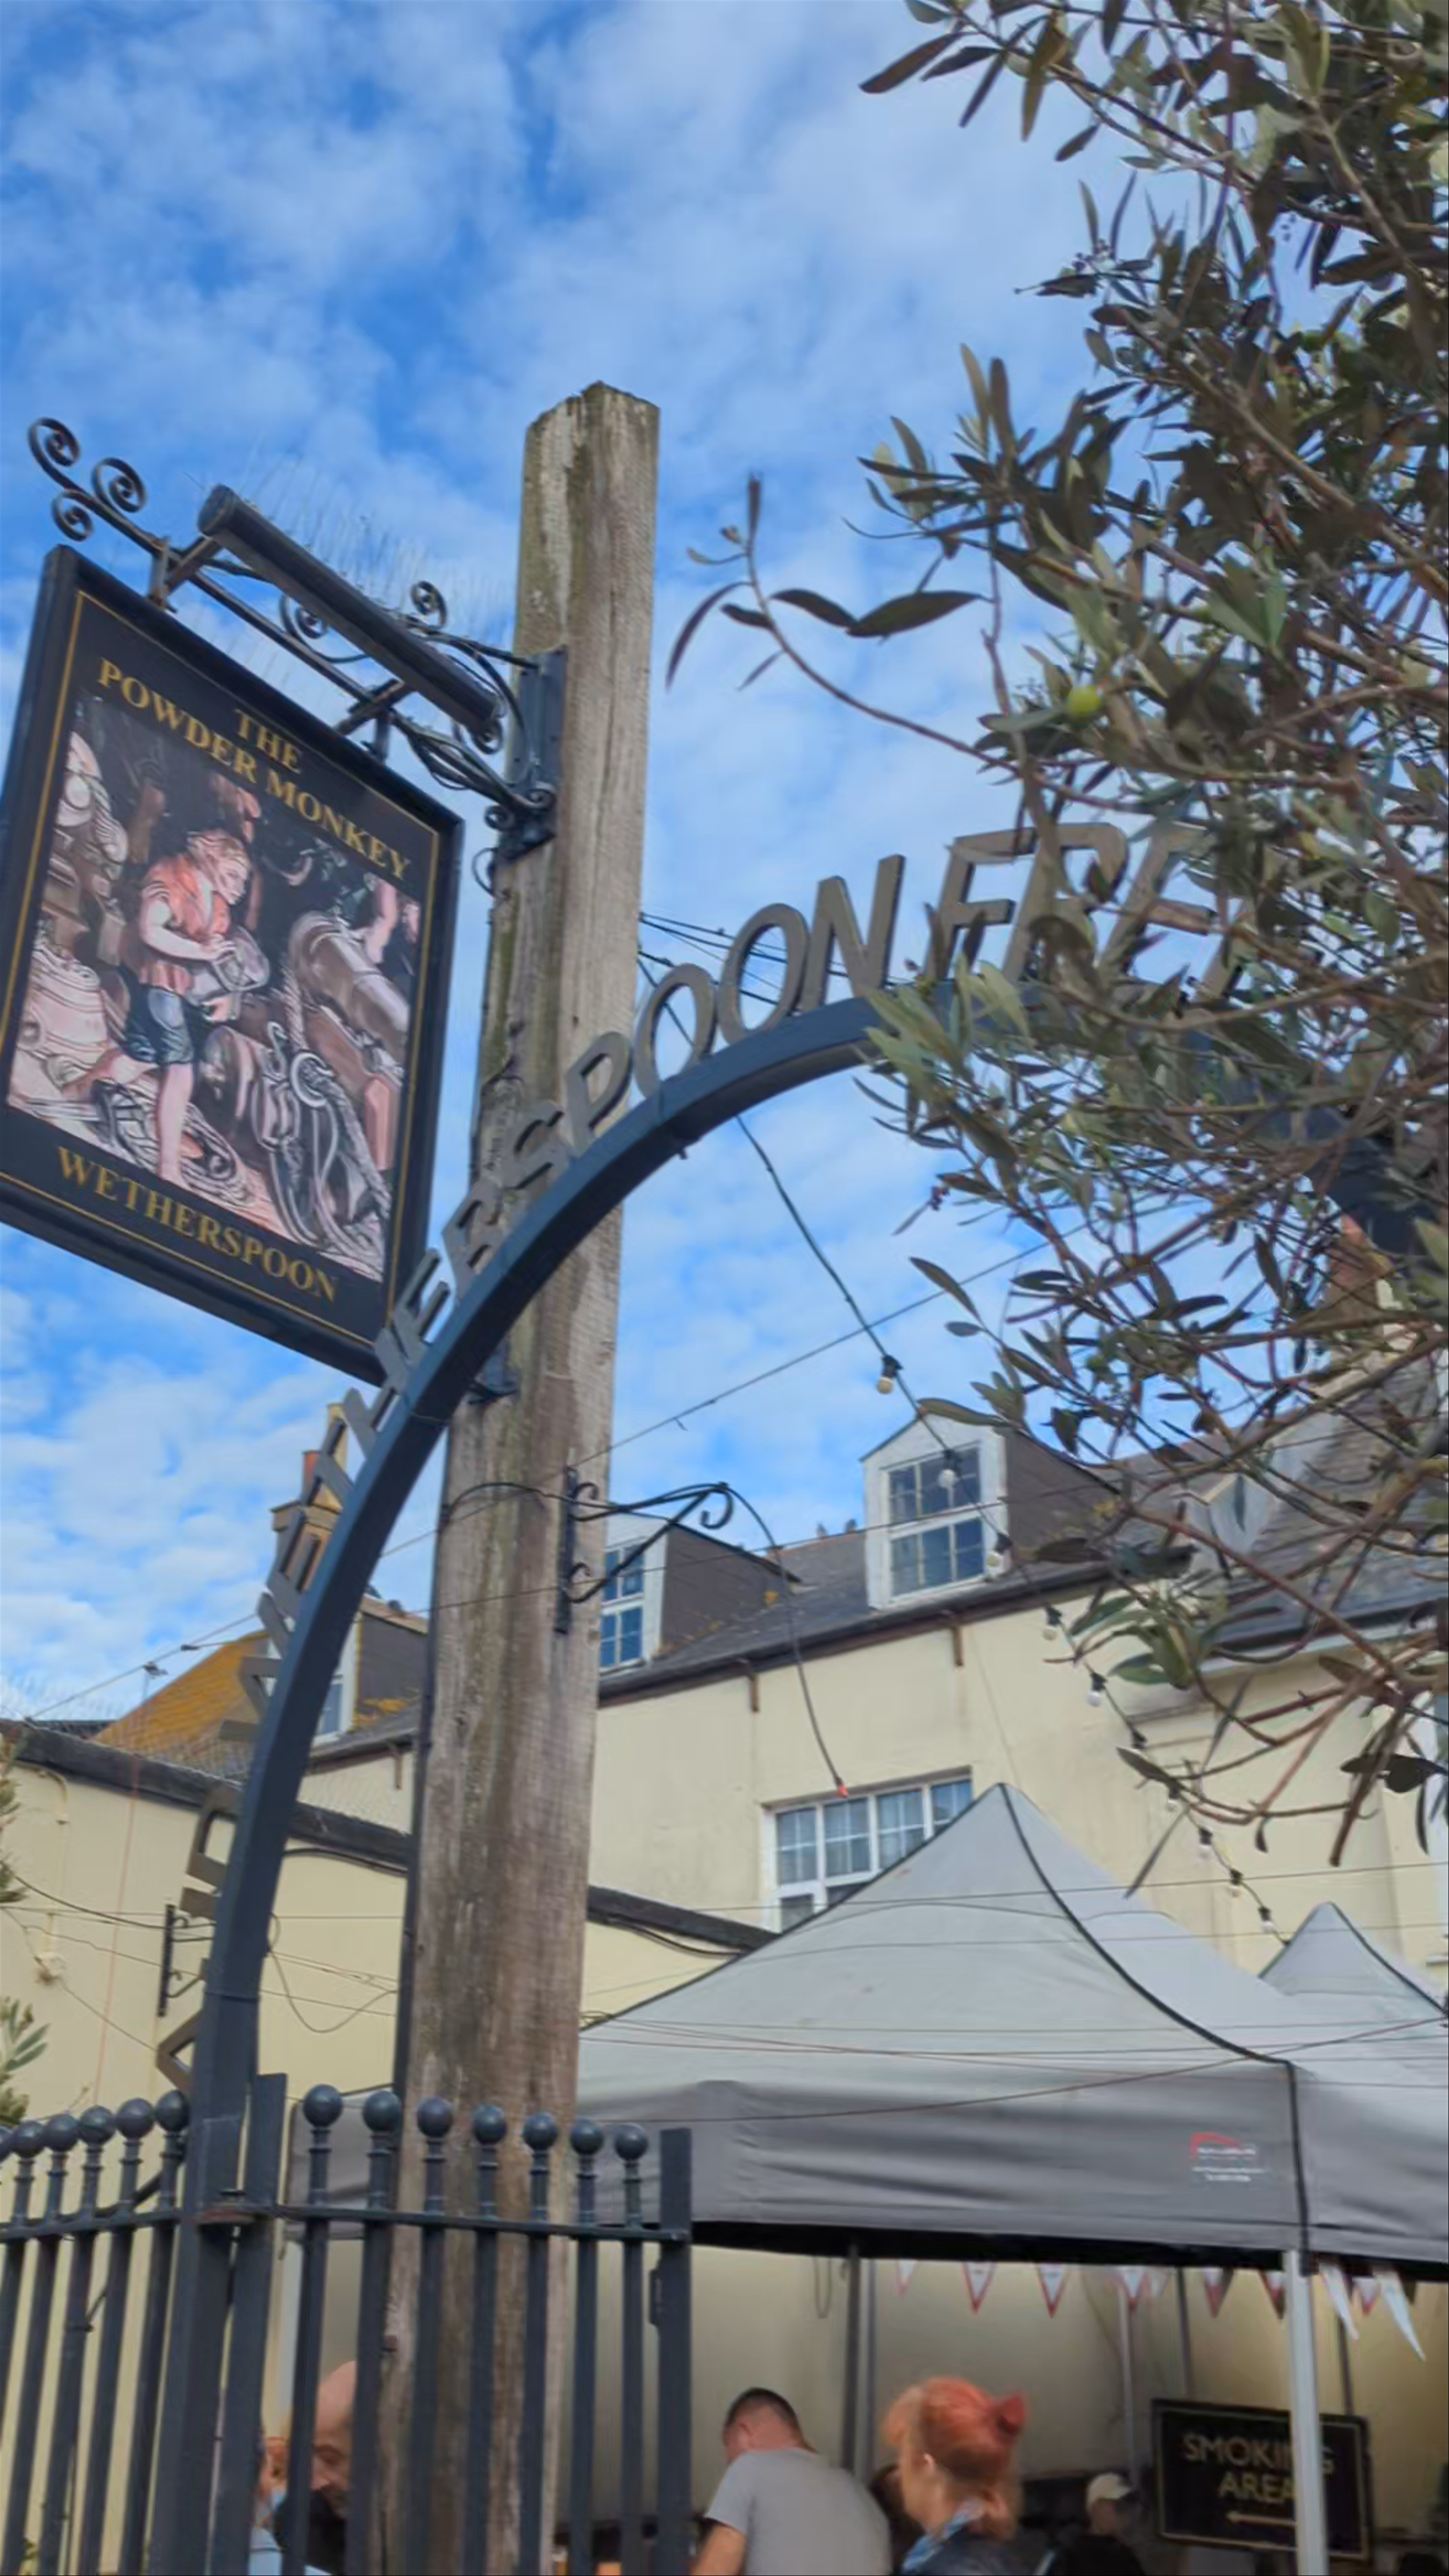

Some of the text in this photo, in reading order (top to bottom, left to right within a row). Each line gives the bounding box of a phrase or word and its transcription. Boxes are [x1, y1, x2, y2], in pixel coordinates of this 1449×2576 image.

[98, 658, 411, 881] POWDER MONKEY
[235, 709, 301, 774] THE
[58, 1146, 338, 1303] WETHERSPOON
[1182, 2431, 1336, 2476] SMOKIG
